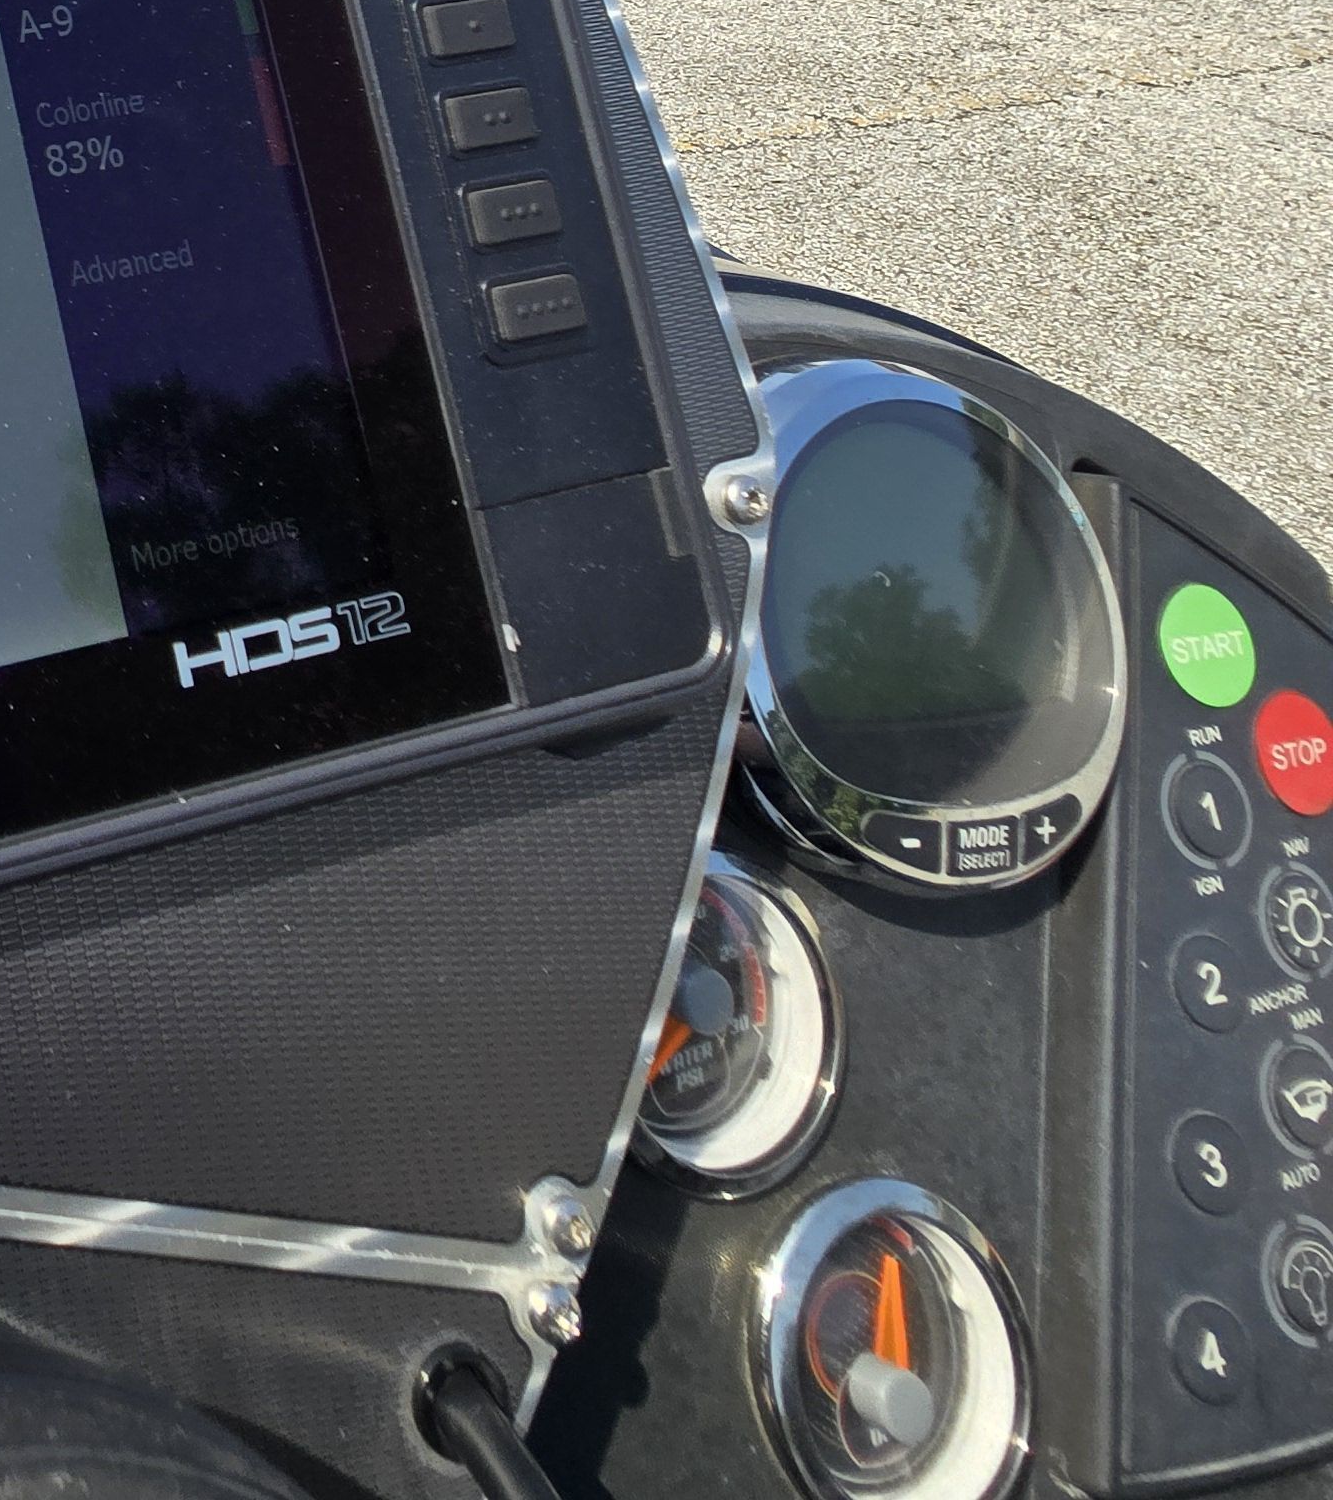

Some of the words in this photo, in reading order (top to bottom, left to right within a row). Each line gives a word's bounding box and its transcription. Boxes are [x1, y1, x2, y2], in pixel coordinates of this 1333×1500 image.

[19, 5, 74, 43] A-9
[36, 95, 145, 127] Colorline
[46, 135, 124, 177] 83%
[72, 239, 194, 286] Advanced
[131, 540, 201, 573] More
[205, 517, 300, 559] options
[1171, 630, 1245, 665] START
[1188, 726, 1223, 746] RUN
[1271, 737, 1328, 771] STOP
[1199, 792, 1222, 830] 1
[958, 825, 1010, 849] MODE
[1282, 836, 1310, 857] NAV
[1194, 875, 1225, 897] IGN
[1198, 961, 1228, 1005] 2
[1248, 984, 1310, 1015] ANCHOR
[1289, 1008, 1324, 1030] MAN
[1198, 1143, 1229, 1188] 3
[1280, 1162, 1321, 1192] AUTO
[1200, 1331, 1228, 1378] 4
